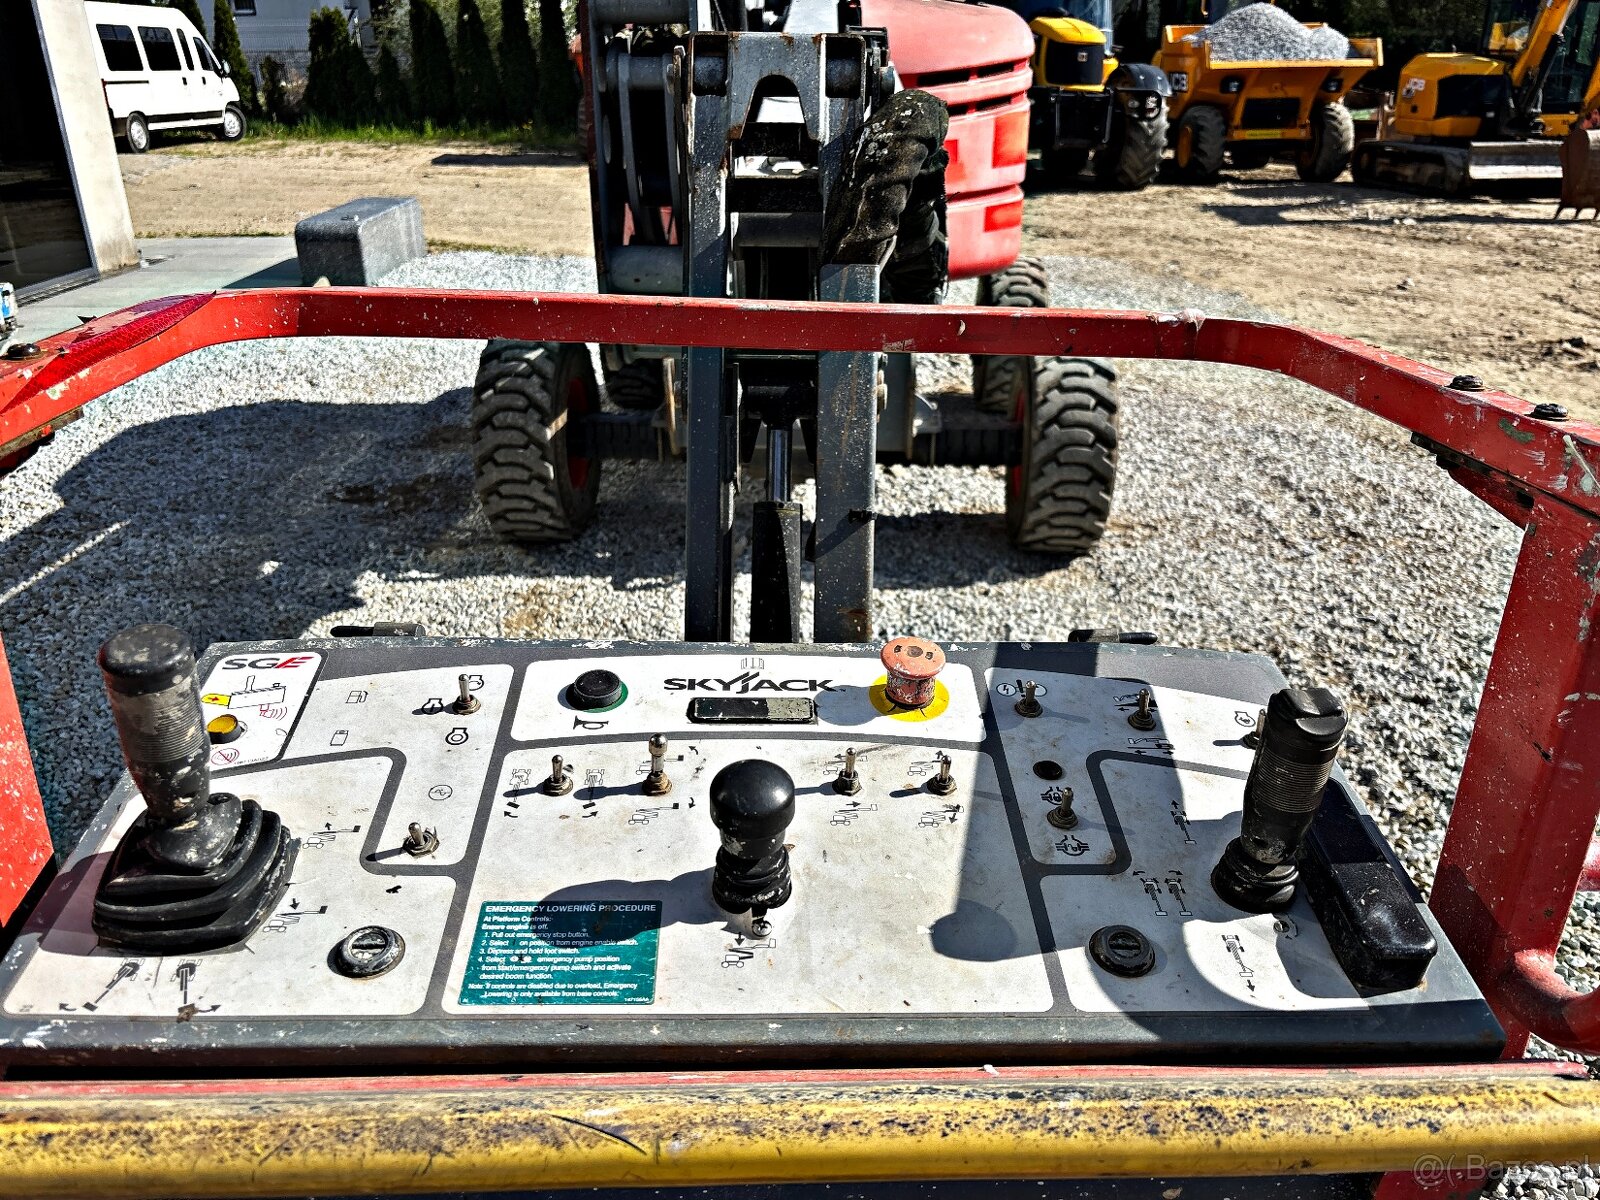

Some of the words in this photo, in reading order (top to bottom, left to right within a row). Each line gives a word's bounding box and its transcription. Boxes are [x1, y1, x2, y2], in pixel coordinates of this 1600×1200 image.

[222, 656, 315, 670] SGE
[663, 671, 838, 695] SKYJACK
[546, 904, 596, 912] LOWERING
[598, 904, 656, 912] PROCEDURE
[528, 939, 555, 947] position
[487, 947, 514, 955] Depress
[536, 956, 574, 964] emergency
[574, 956, 593, 964] pump
[594, 955, 620, 963] position
[497, 964, 550, 972] start/emergency
[550, 964, 570, 972] pump
[603, 982, 638, 990] Emergency
